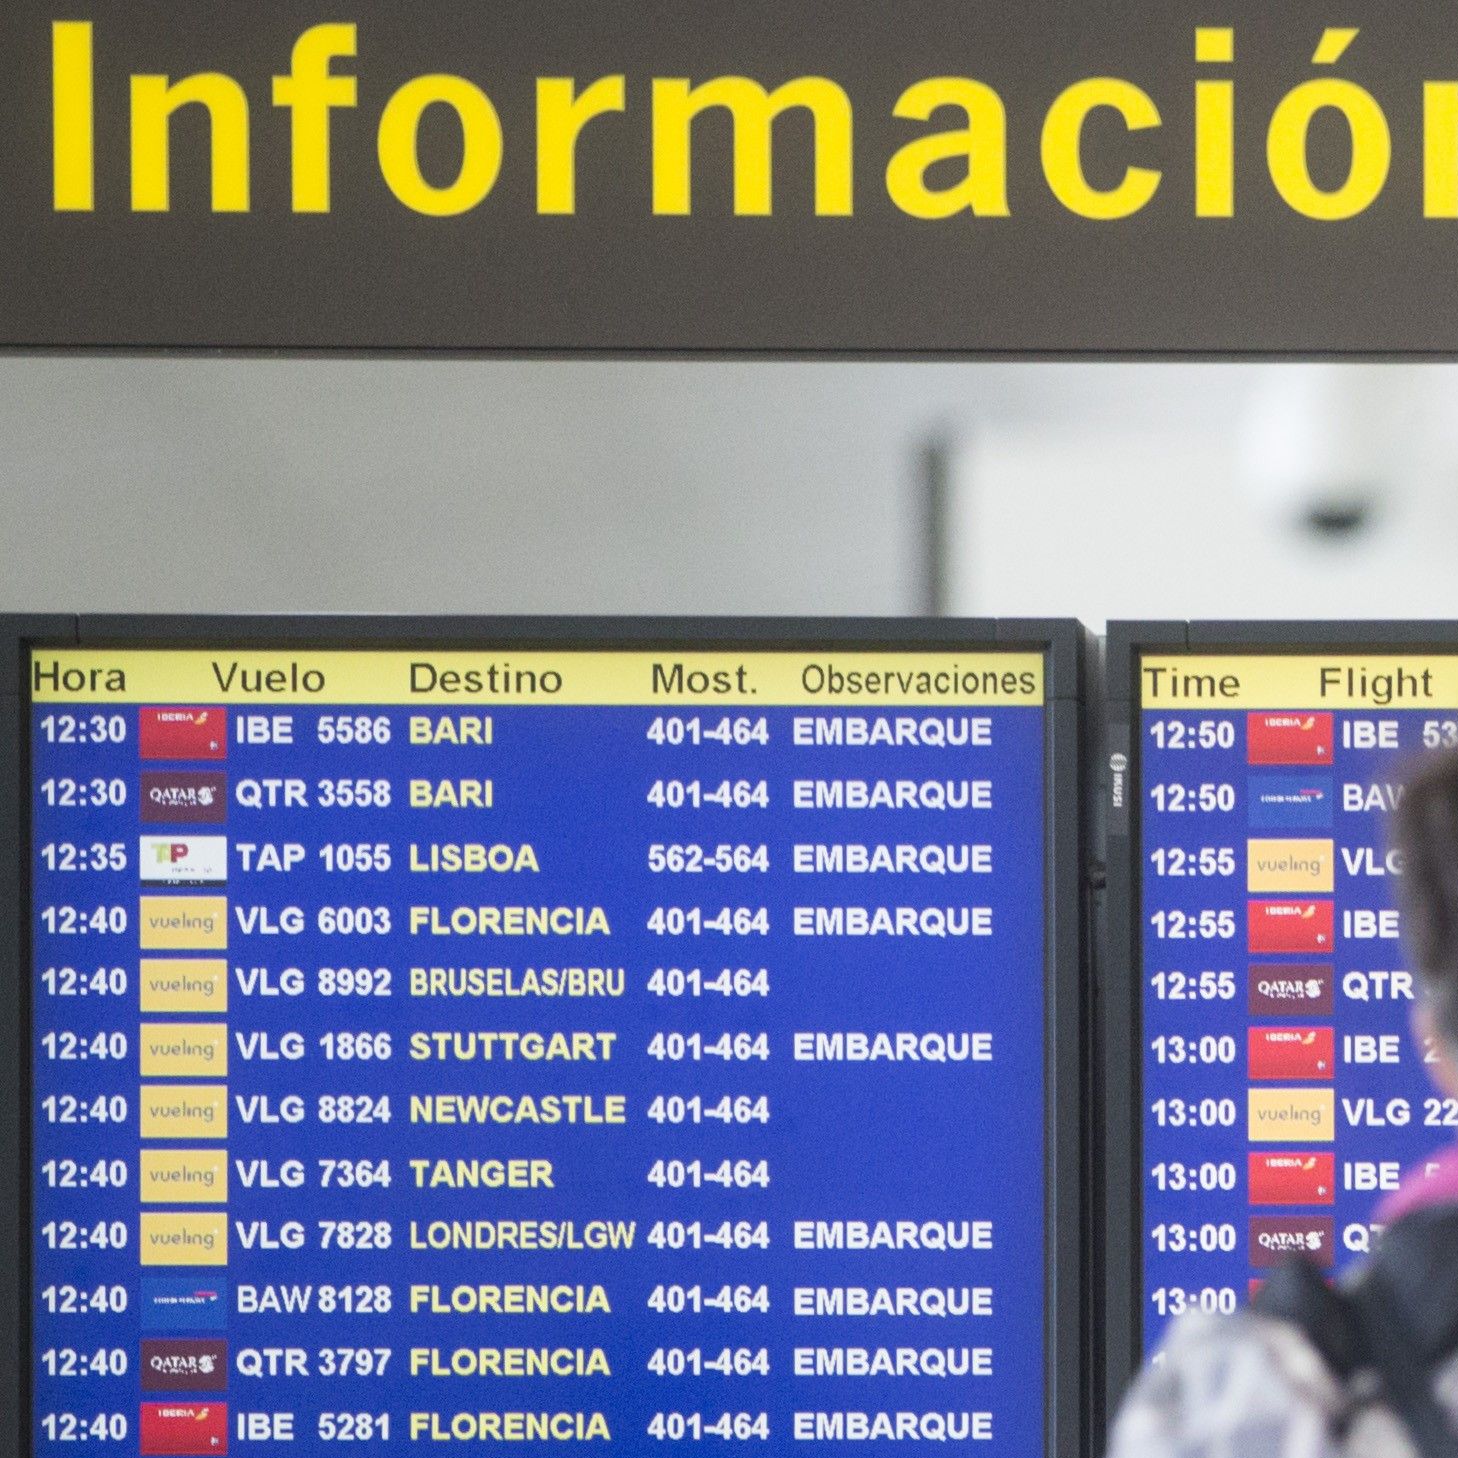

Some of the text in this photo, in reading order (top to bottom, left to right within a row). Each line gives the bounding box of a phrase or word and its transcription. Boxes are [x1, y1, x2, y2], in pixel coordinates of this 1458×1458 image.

[32, 661, 1036, 695] Hora Vuelo Destino Most. Observaciones
[1143, 667, 1240, 698] Time
[1320, 667, 1433, 702] Flight
[41, 714, 992, 748] 12:30 IBE 5586 BARI 401-464 EMBARQUE
[1150, 720, 1399, 749] 12:50 IBE
[41, 778, 127, 806] 12:30
[235, 778, 309, 809] QTR
[318, 779, 391, 807] 3558
[409, 779, 493, 808] BARI
[646, 779, 770, 808] 401-464
[793, 780, 993, 810] EMBARQUE
[41, 905, 128, 934] 12:40
[234, 906, 305, 935] VLG
[317, 906, 392, 935] 6003
[410, 906, 611, 935] FLORENCIA
[646, 907, 770, 936] 401-464
[793, 907, 993, 938] EMBARQUE
[1151, 1035, 1400, 1064] 13:00 IBE
[41, 1220, 993, 1251] 12:40 VLG 7828 LONDRES/LGW 401-464 EMBARQUE
